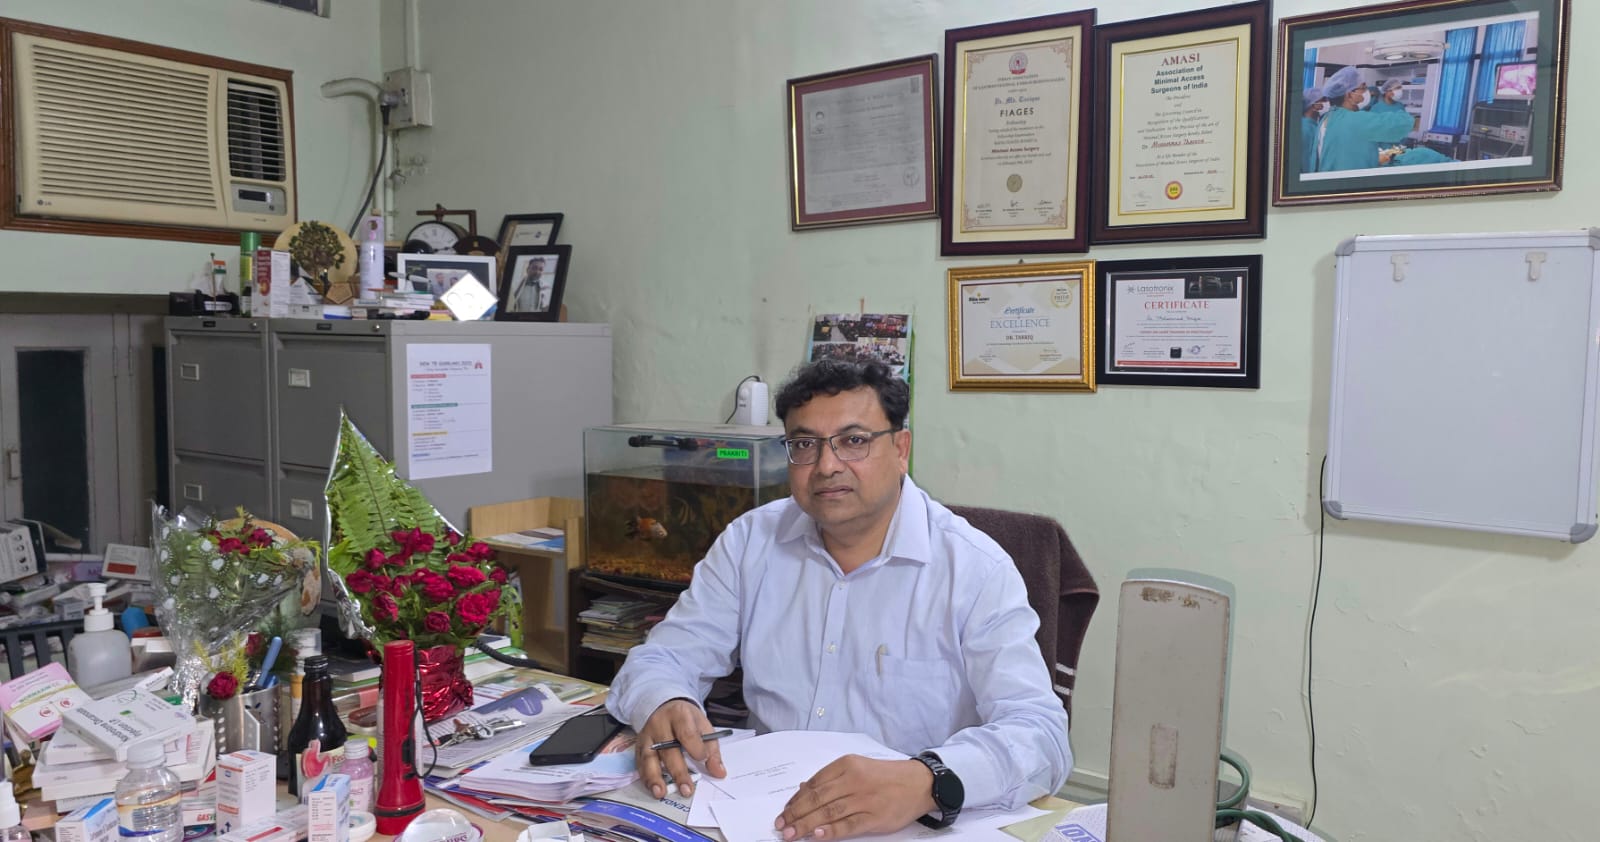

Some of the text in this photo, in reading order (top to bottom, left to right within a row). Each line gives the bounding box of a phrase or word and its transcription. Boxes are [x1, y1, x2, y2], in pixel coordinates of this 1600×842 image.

[1161, 52, 1200, 67] AMASI
[1156, 67, 1194, 76] Association
[1154, 74, 1204, 85] Minimal Access
[1151, 86, 1181, 94] Surgeons
[1000, 107, 1034, 117] FIAGES
[1144, 300, 1209, 310] CERTIFICATE
[990, 318, 1049, 329] EXCELLENCE
